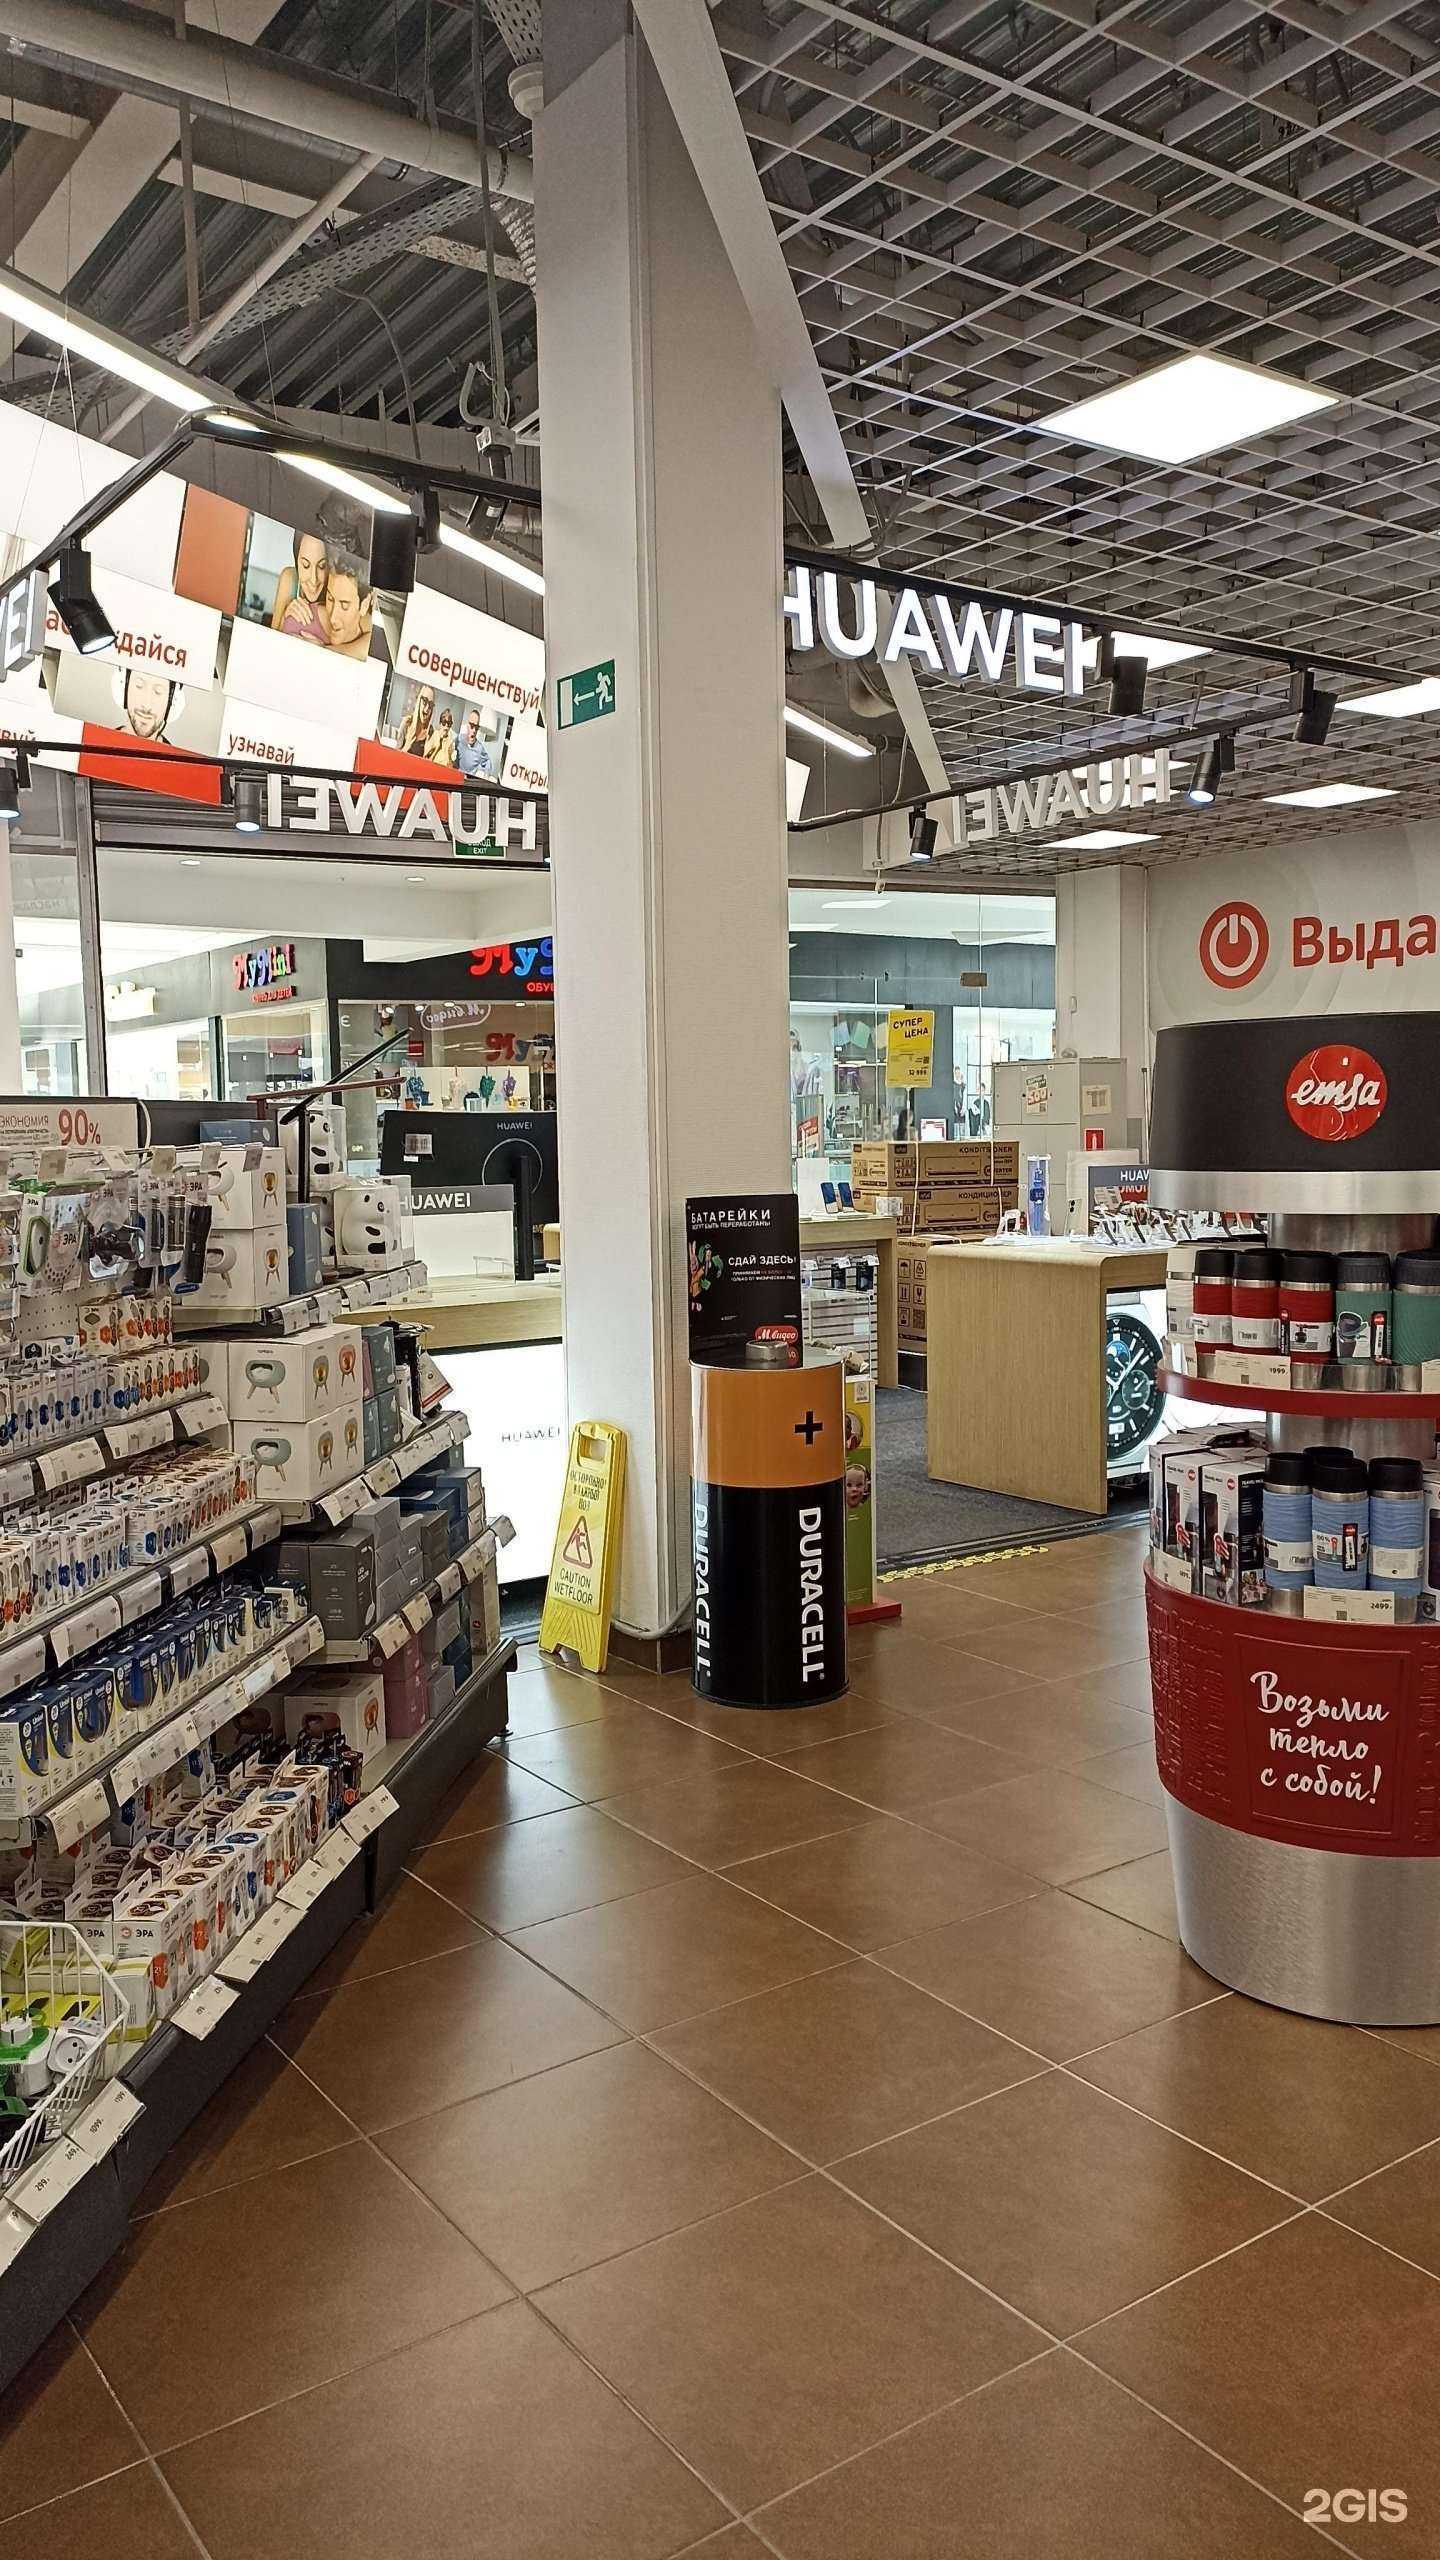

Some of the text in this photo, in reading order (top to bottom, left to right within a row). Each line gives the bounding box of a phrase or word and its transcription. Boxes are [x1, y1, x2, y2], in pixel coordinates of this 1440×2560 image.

[784, 567, 1086, 697] HUAWEI
[408, 644, 540, 714] совершенствуй
[227, 732, 295, 766] узнавай
[1293, 914, 1437, 969] Выда
[893, 1017, 923, 1029] СУПЕР
[904, 1027, 929, 1039] ЦЕНА
[1290, 1073, 1381, 1112] emsa
[0, 1114, 49, 1129] ЭКОНОМИЯ
[58, 1108, 101, 1146] 90%
[497, 1121, 533, 1131] HUAWEI
[189, 1182, 203, 1192] ЭРА
[400, 1192, 471, 1210] HUAWEI
[691, 1208, 771, 1223] БАТАРЕЙКИ
[63, 1233, 77, 1246] ЭРА
[728, 1254, 757, 1267] СДАЙ
[560, 1568, 592, 1589] CAUTION
[694, 1503, 712, 1673] DURACELL
[554, 1582, 593, 1605] WETFLOOR
[799, 1506, 825, 1683] DURACELL
[1250, 1671, 1390, 1728] Возьми
[1269, 1727, 1369, 1761] тепло
[1261, 1764, 1382, 1804] с собой!
[87, 1929, 105, 1938] ЭРА
[136, 1929, 154, 1938] ЭРА
